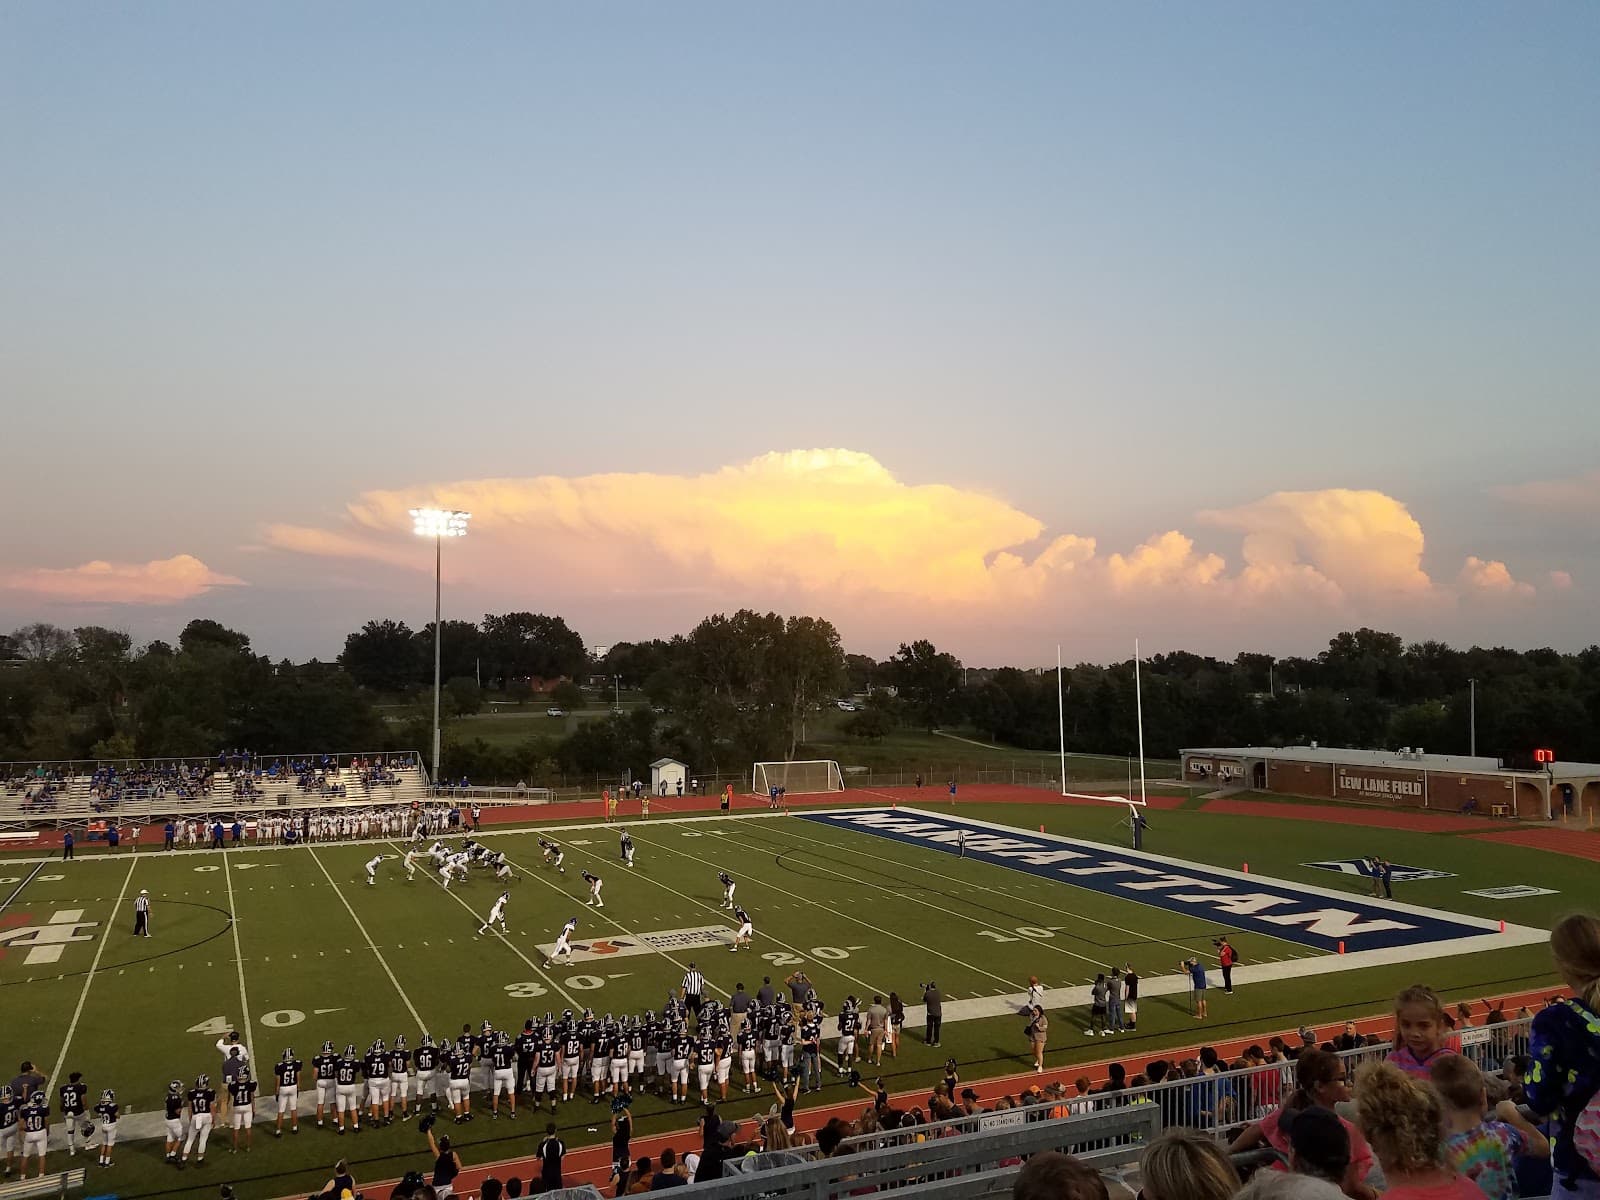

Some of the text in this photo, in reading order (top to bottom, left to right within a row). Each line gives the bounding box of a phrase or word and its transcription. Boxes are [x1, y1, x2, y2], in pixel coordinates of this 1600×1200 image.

[1340, 775, 1422, 796] LEW LANE FIELD
[827, 812, 1421, 938] MANHATTAN
[541, 1049, 554, 1064] 53
[677, 1043, 691, 1059] 54
[700, 1048, 714, 1062] 56
[420, 1054, 432, 1068] 96
[494, 1053, 506, 1067] 71
[371, 1062, 386, 1076] 79
[63, 1091, 78, 1108] 32
[235, 1090, 249, 1104] 41
[26, 1115, 43, 1131] 40
